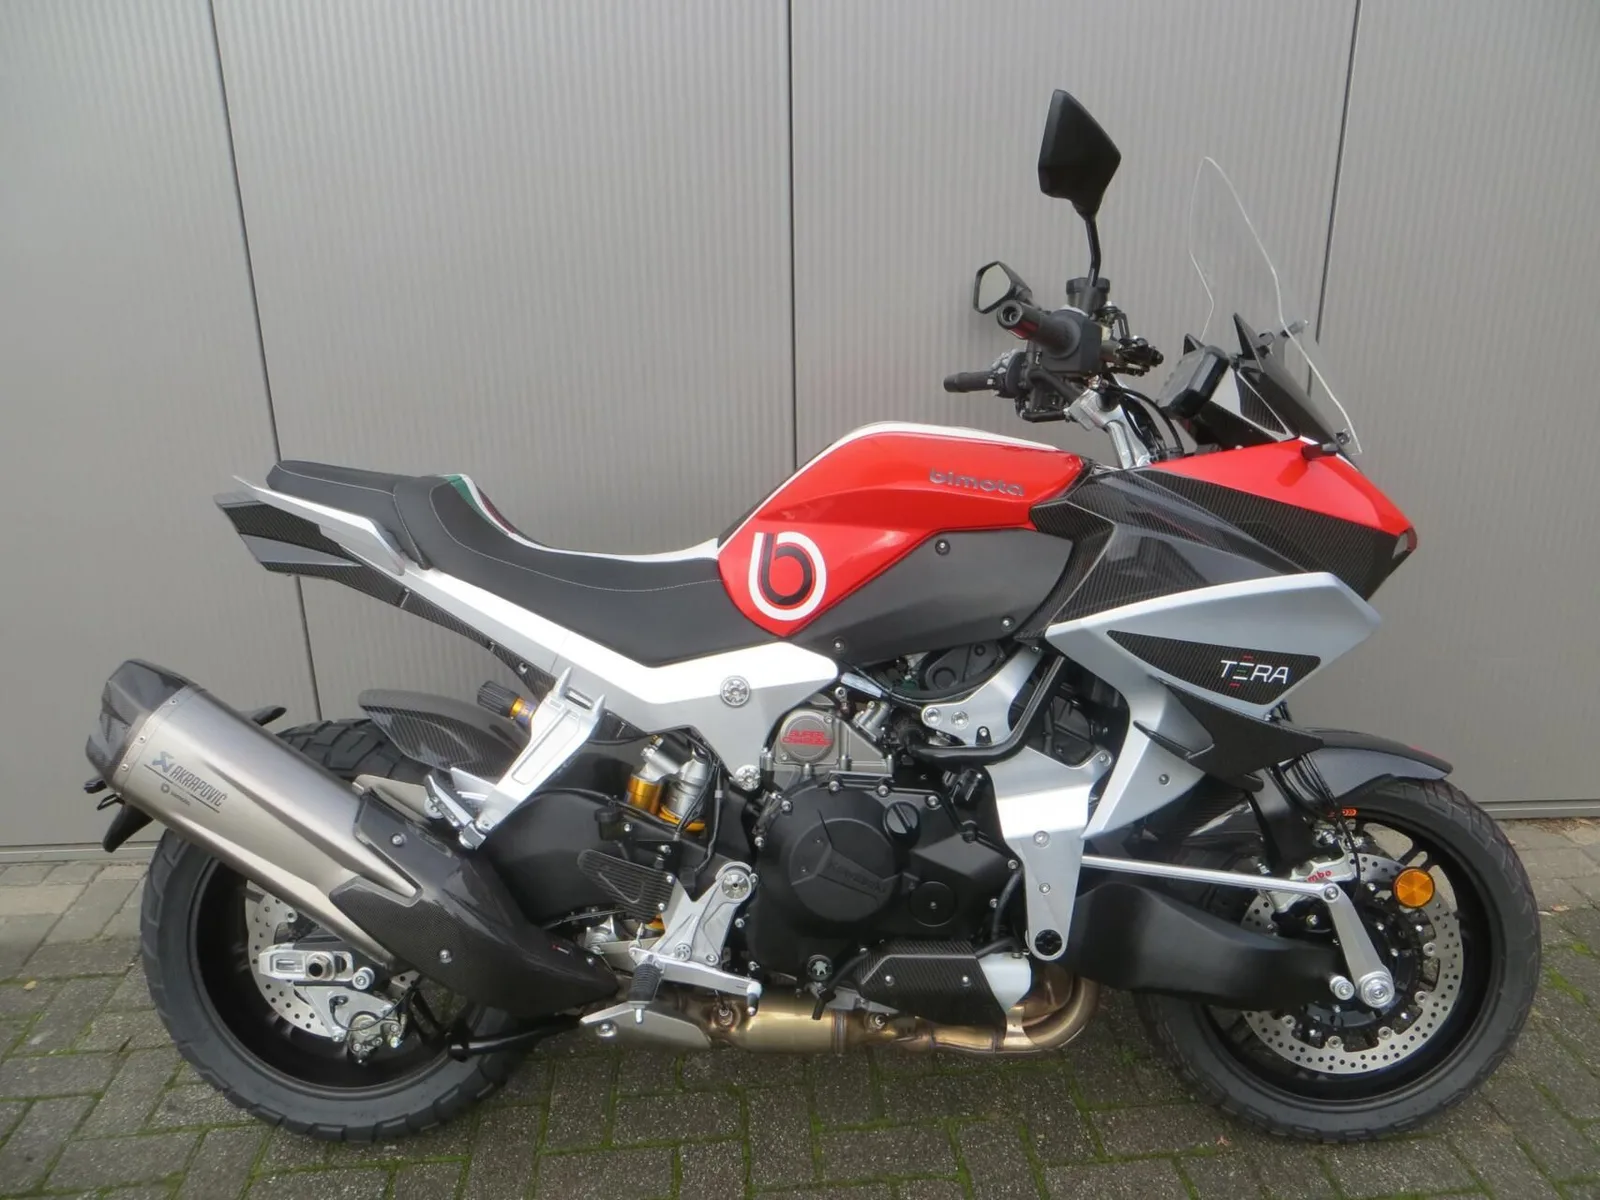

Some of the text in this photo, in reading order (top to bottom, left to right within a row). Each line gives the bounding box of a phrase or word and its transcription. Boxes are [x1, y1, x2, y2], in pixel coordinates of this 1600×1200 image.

[929, 467, 1025, 497] bimota
[1220, 659, 1289, 685] TERA
[1307, 870, 1333, 883] mbo
